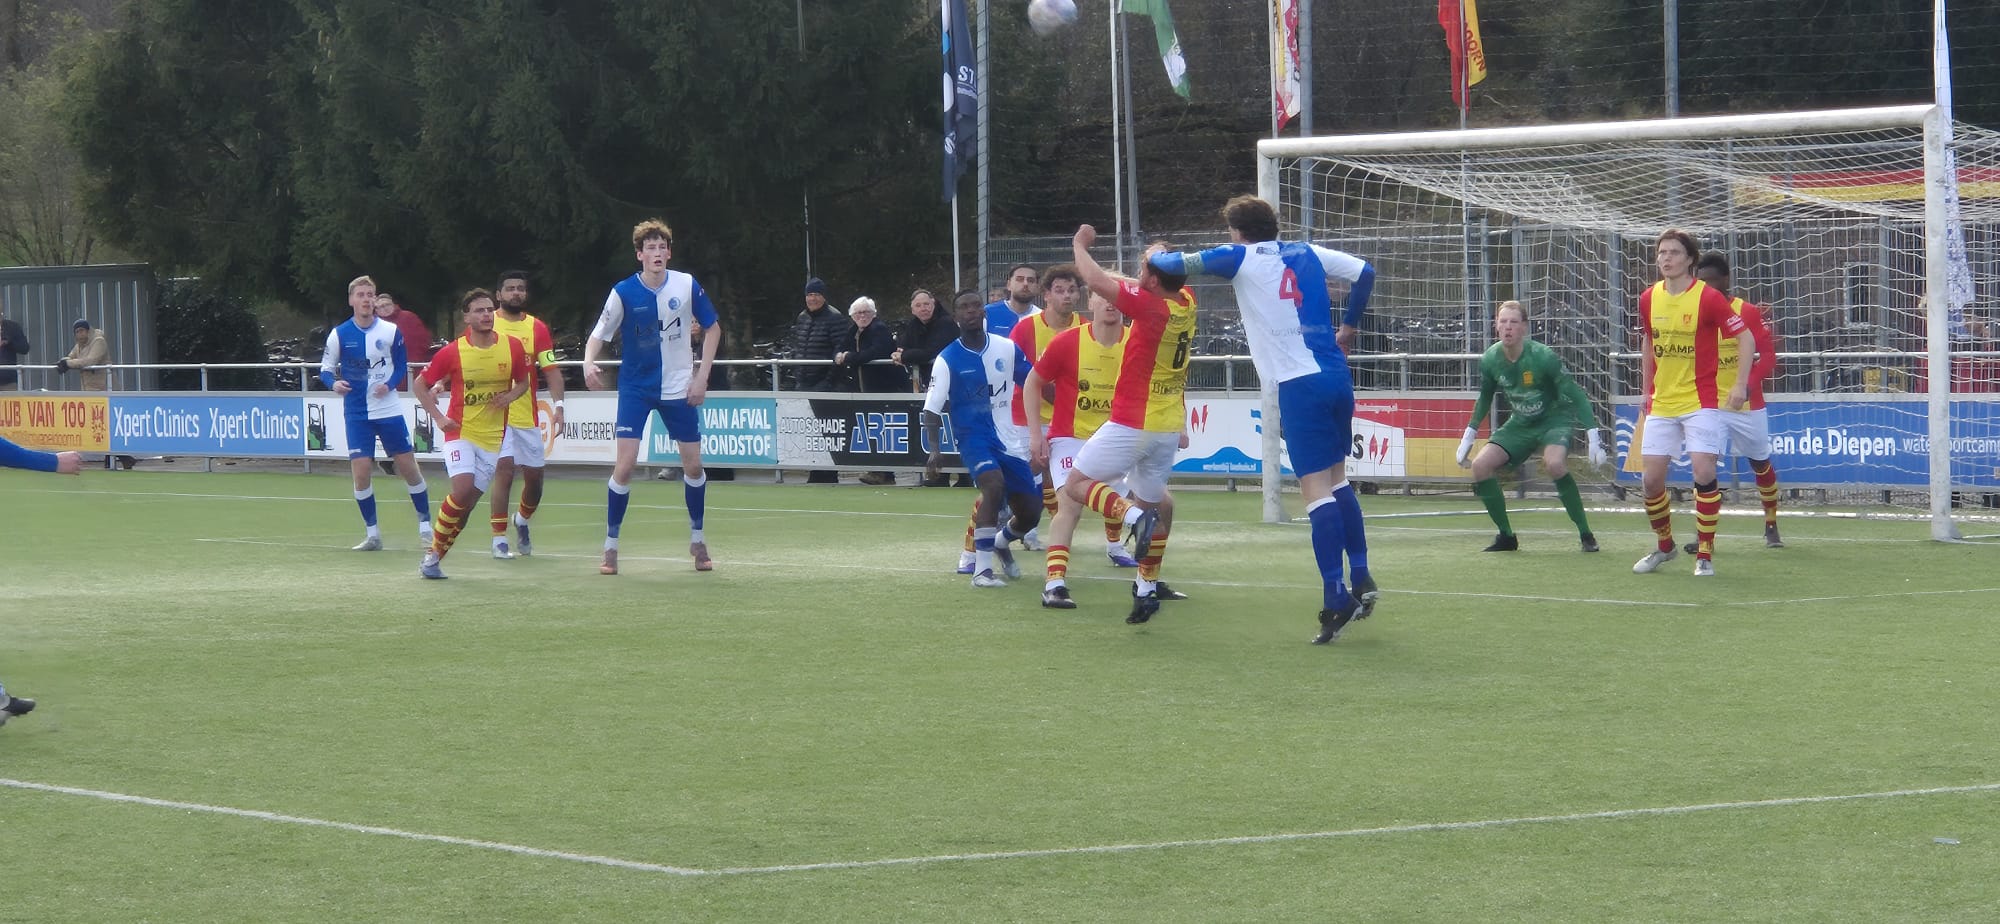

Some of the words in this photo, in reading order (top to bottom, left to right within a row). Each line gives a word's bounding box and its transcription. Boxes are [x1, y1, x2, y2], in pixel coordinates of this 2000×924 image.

[1279, 270, 1304, 309] 4
[27, 401, 55, 428] VAN
[61, 401, 86, 429] 100
[114, 406, 151, 447] Xpert
[153, 405, 200, 438] Clinics
[702, 408, 729, 430] VAN
[730, 408, 772, 430] AFVAL
[779, 416, 847, 435] AUTOSCHADE
[208, 407, 250, 448] Xpert
[251, 407, 300, 440] Clinics
[562, 421, 579, 440] VAN
[580, 421, 618, 441] GERREV
[849, 412, 909, 454] ARIE
[450, 449, 461, 462] 19
[654, 433, 681, 455] NAA
[700, 434, 772, 457] RONDSTOF
[805, 436, 847, 452] BEDRIJF
[1767, 435, 1796, 455] sen
[1799, 427, 1824, 456] de
[1827, 429, 1897, 465] Diepen
[1060, 456, 1073, 469] 18
